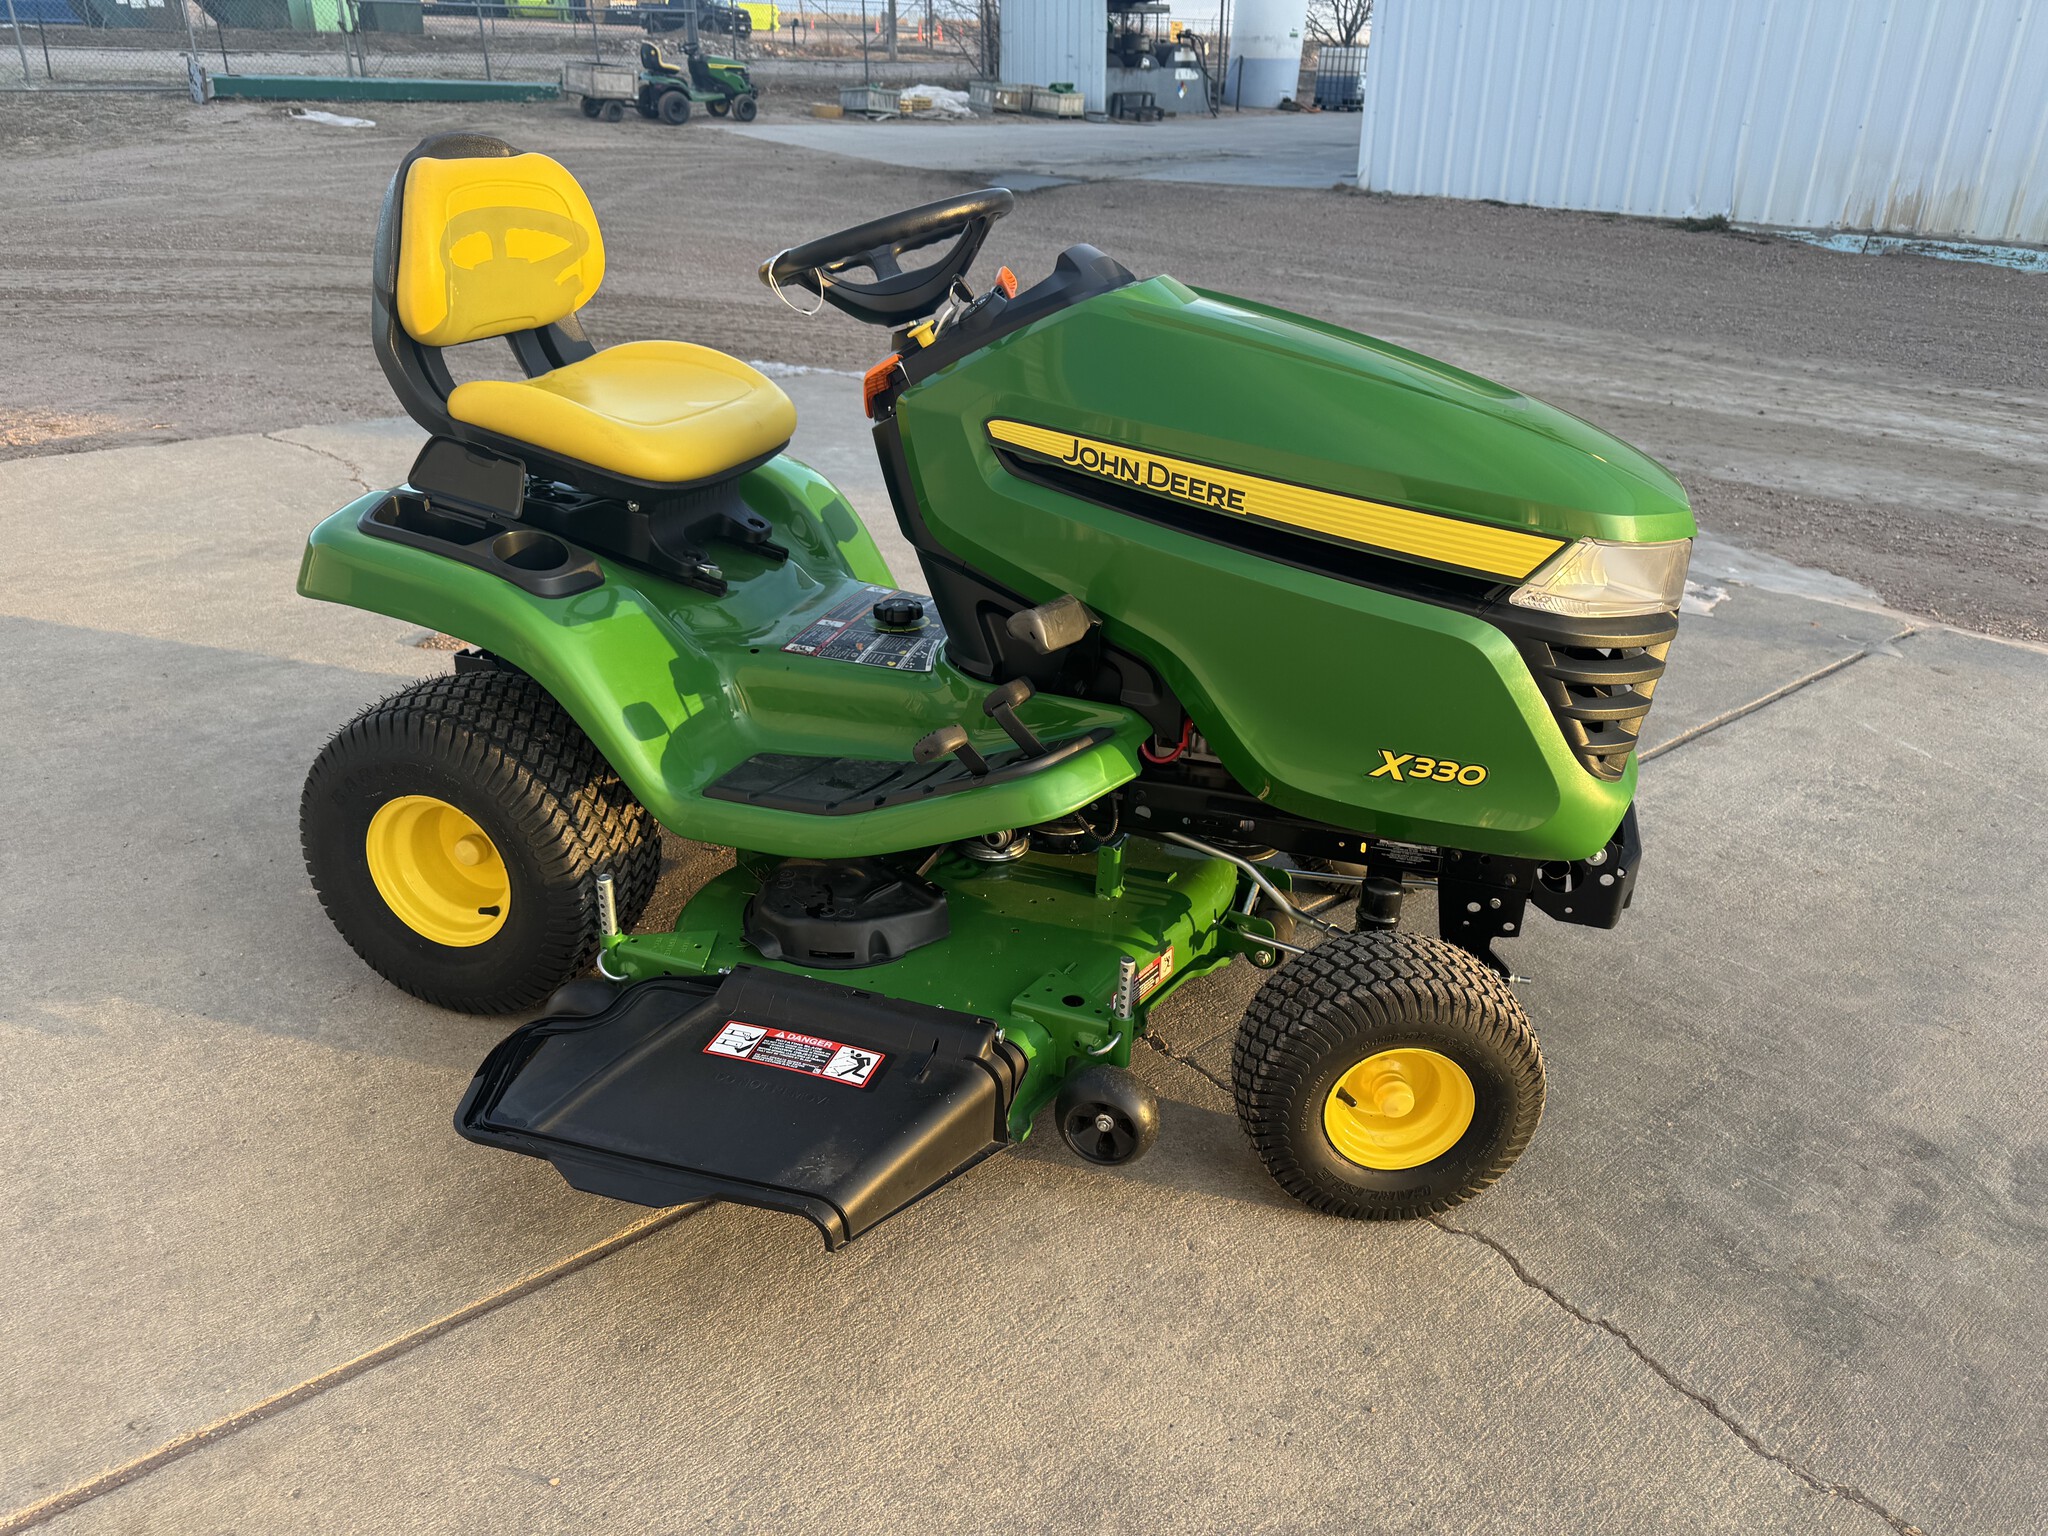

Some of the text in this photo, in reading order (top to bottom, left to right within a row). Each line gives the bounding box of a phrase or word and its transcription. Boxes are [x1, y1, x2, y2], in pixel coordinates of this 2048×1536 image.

[1063, 439, 1246, 513] JOHN DEERE
[1367, 748, 1489, 788] X330
[786, 1033, 833, 1049] DANGER
[1314, 1165, 1433, 1201] CARLISLE
